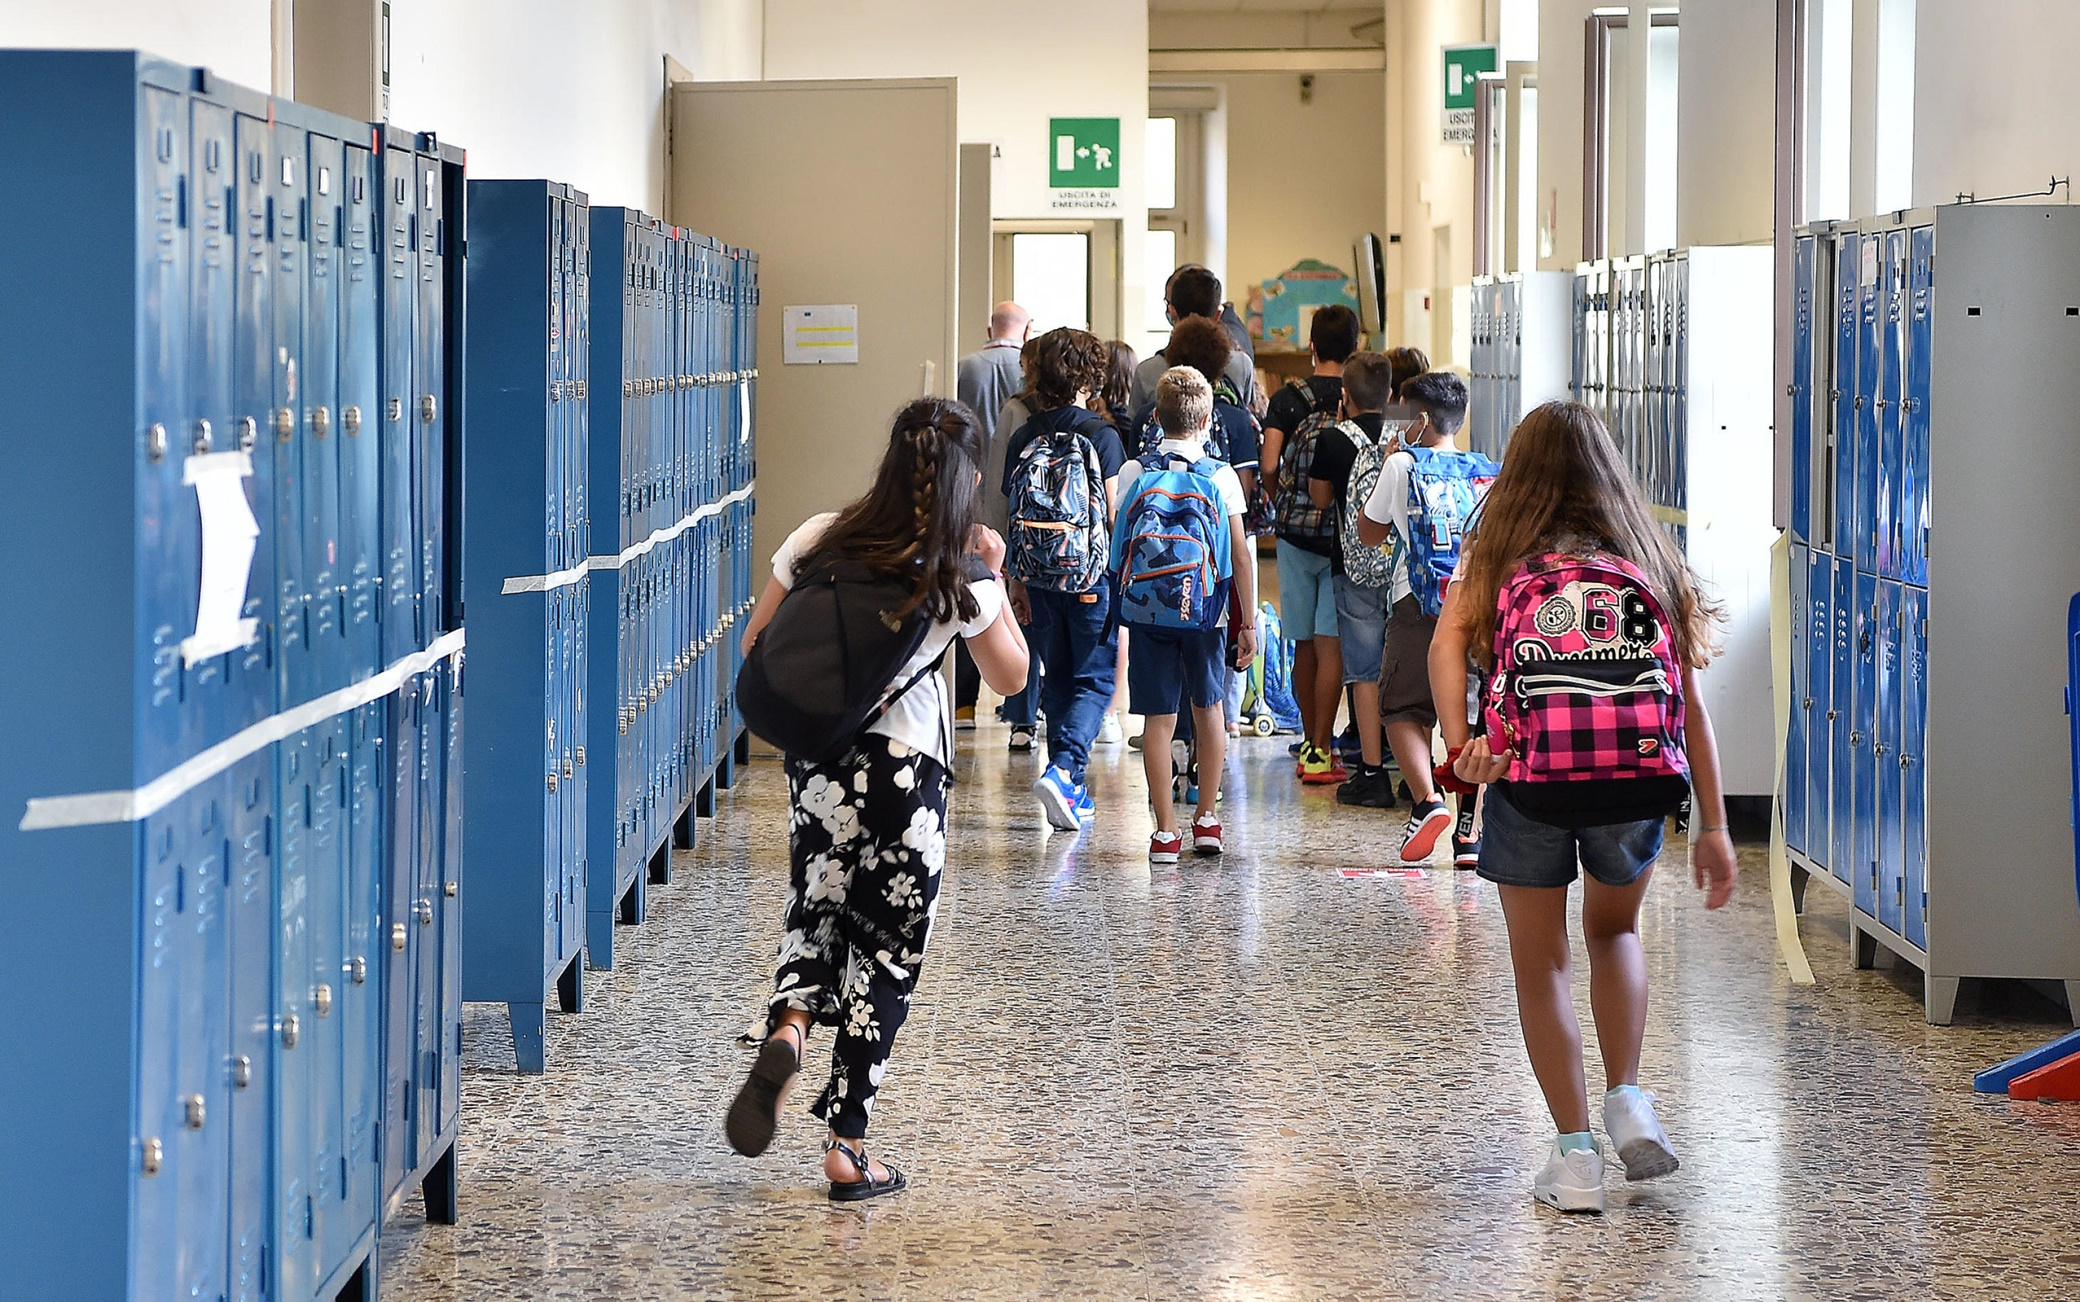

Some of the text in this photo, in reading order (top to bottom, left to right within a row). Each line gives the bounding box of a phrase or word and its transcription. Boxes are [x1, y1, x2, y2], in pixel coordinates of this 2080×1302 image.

[1449, 112, 1475, 124] USCIT
[1443, 128, 1475, 140] EMERG
[1059, 191, 1111, 199] USCITA DI
[1581, 588, 1659, 649] 68
